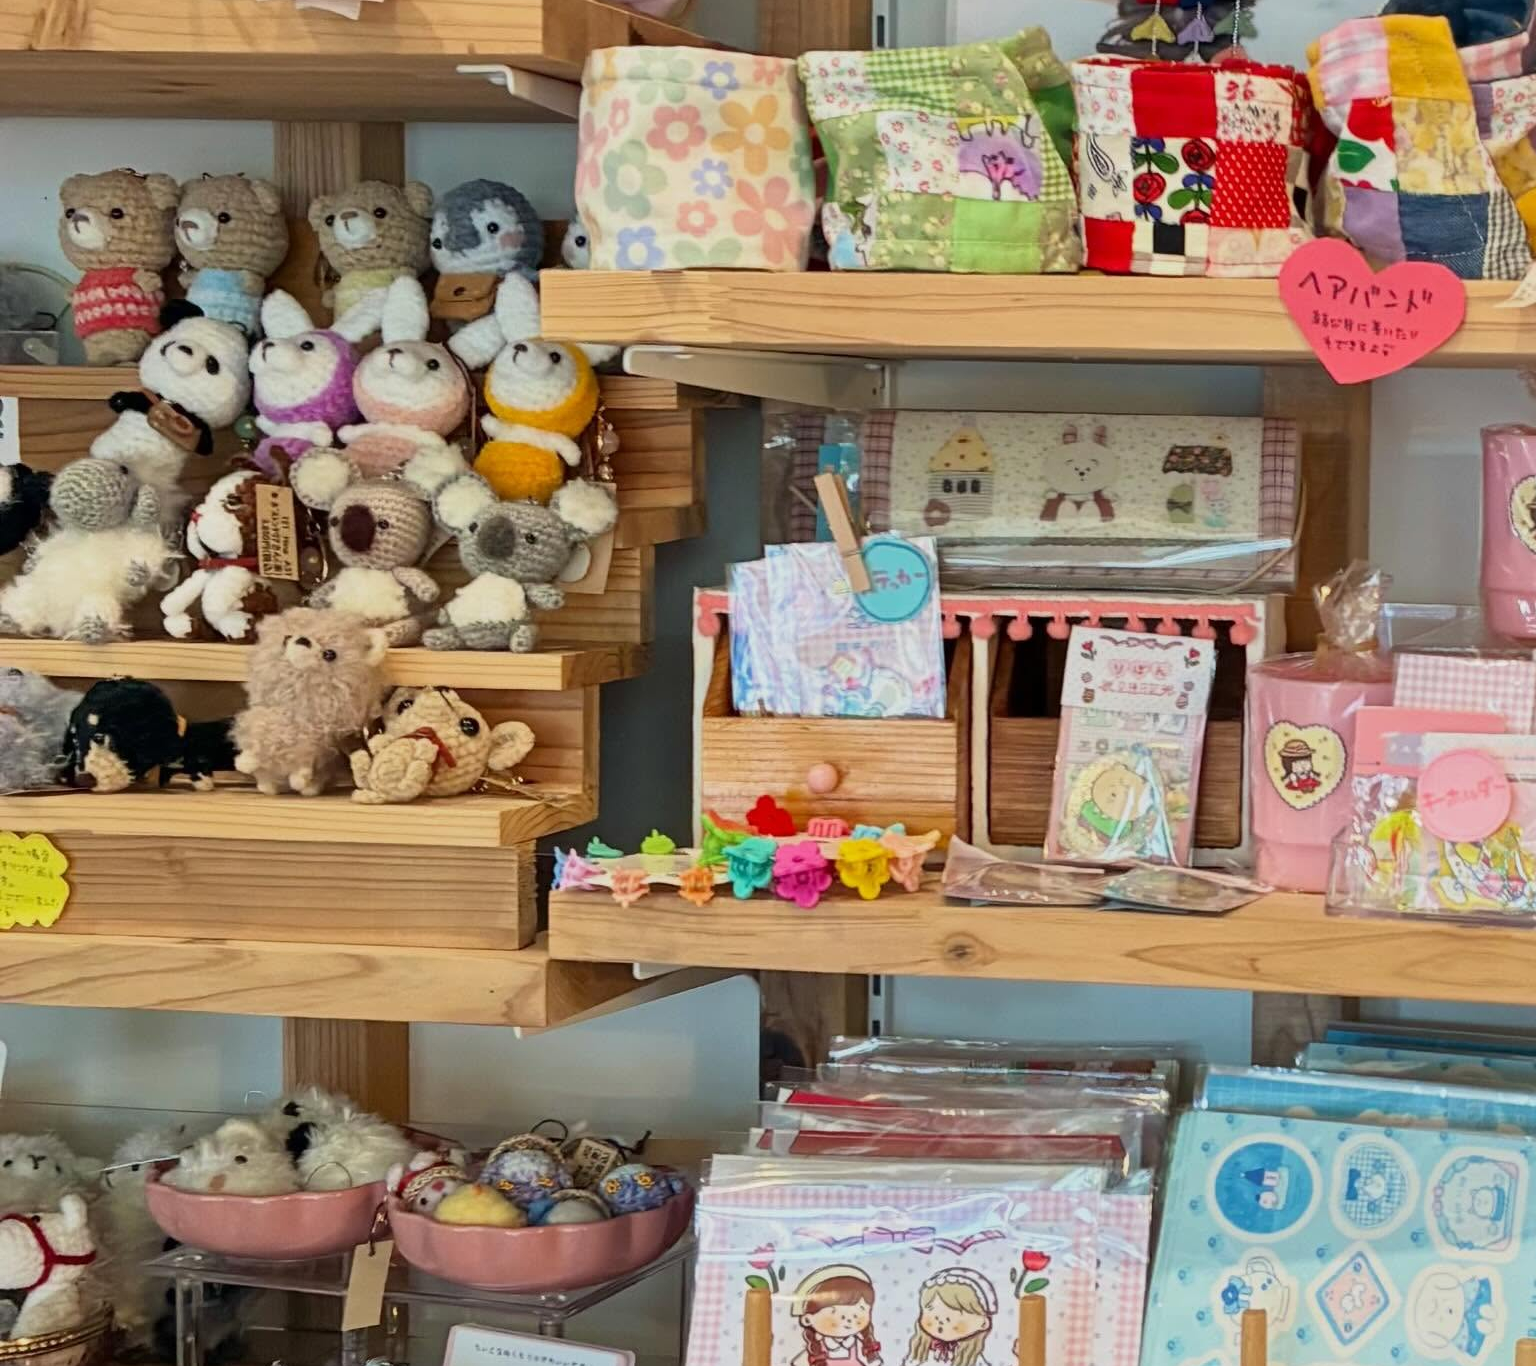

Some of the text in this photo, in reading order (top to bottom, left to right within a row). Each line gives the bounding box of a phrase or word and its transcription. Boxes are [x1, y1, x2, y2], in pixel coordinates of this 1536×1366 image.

[1298, 271, 1433, 314] ヘアバンド
